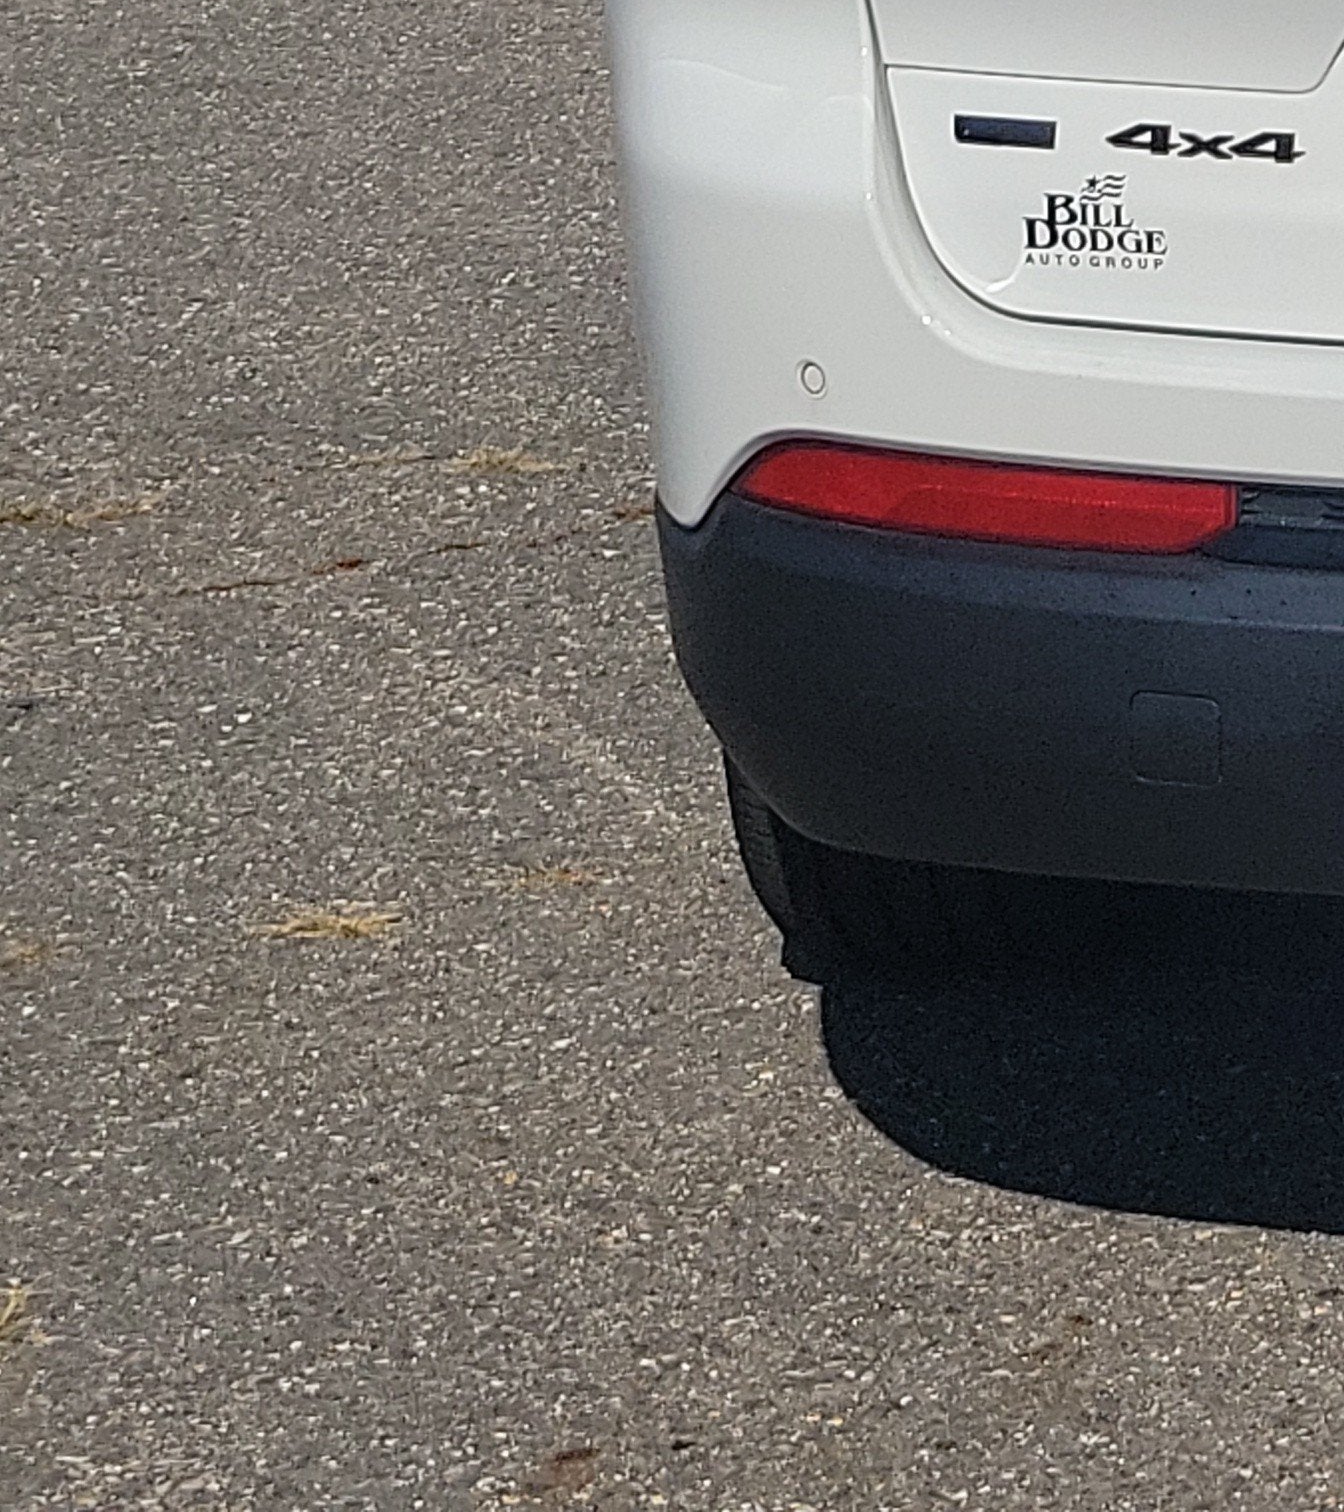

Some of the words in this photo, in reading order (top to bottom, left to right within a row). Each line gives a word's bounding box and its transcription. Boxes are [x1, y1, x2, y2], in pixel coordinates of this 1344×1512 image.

[1105, 122, 1306, 164] 4x4
[1044, 193, 1135, 228] BILL
[1022, 216, 1168, 255] DODGE
[1024, 253, 1081, 268] AUTO
[1088, 255, 1165, 271] GROUP
